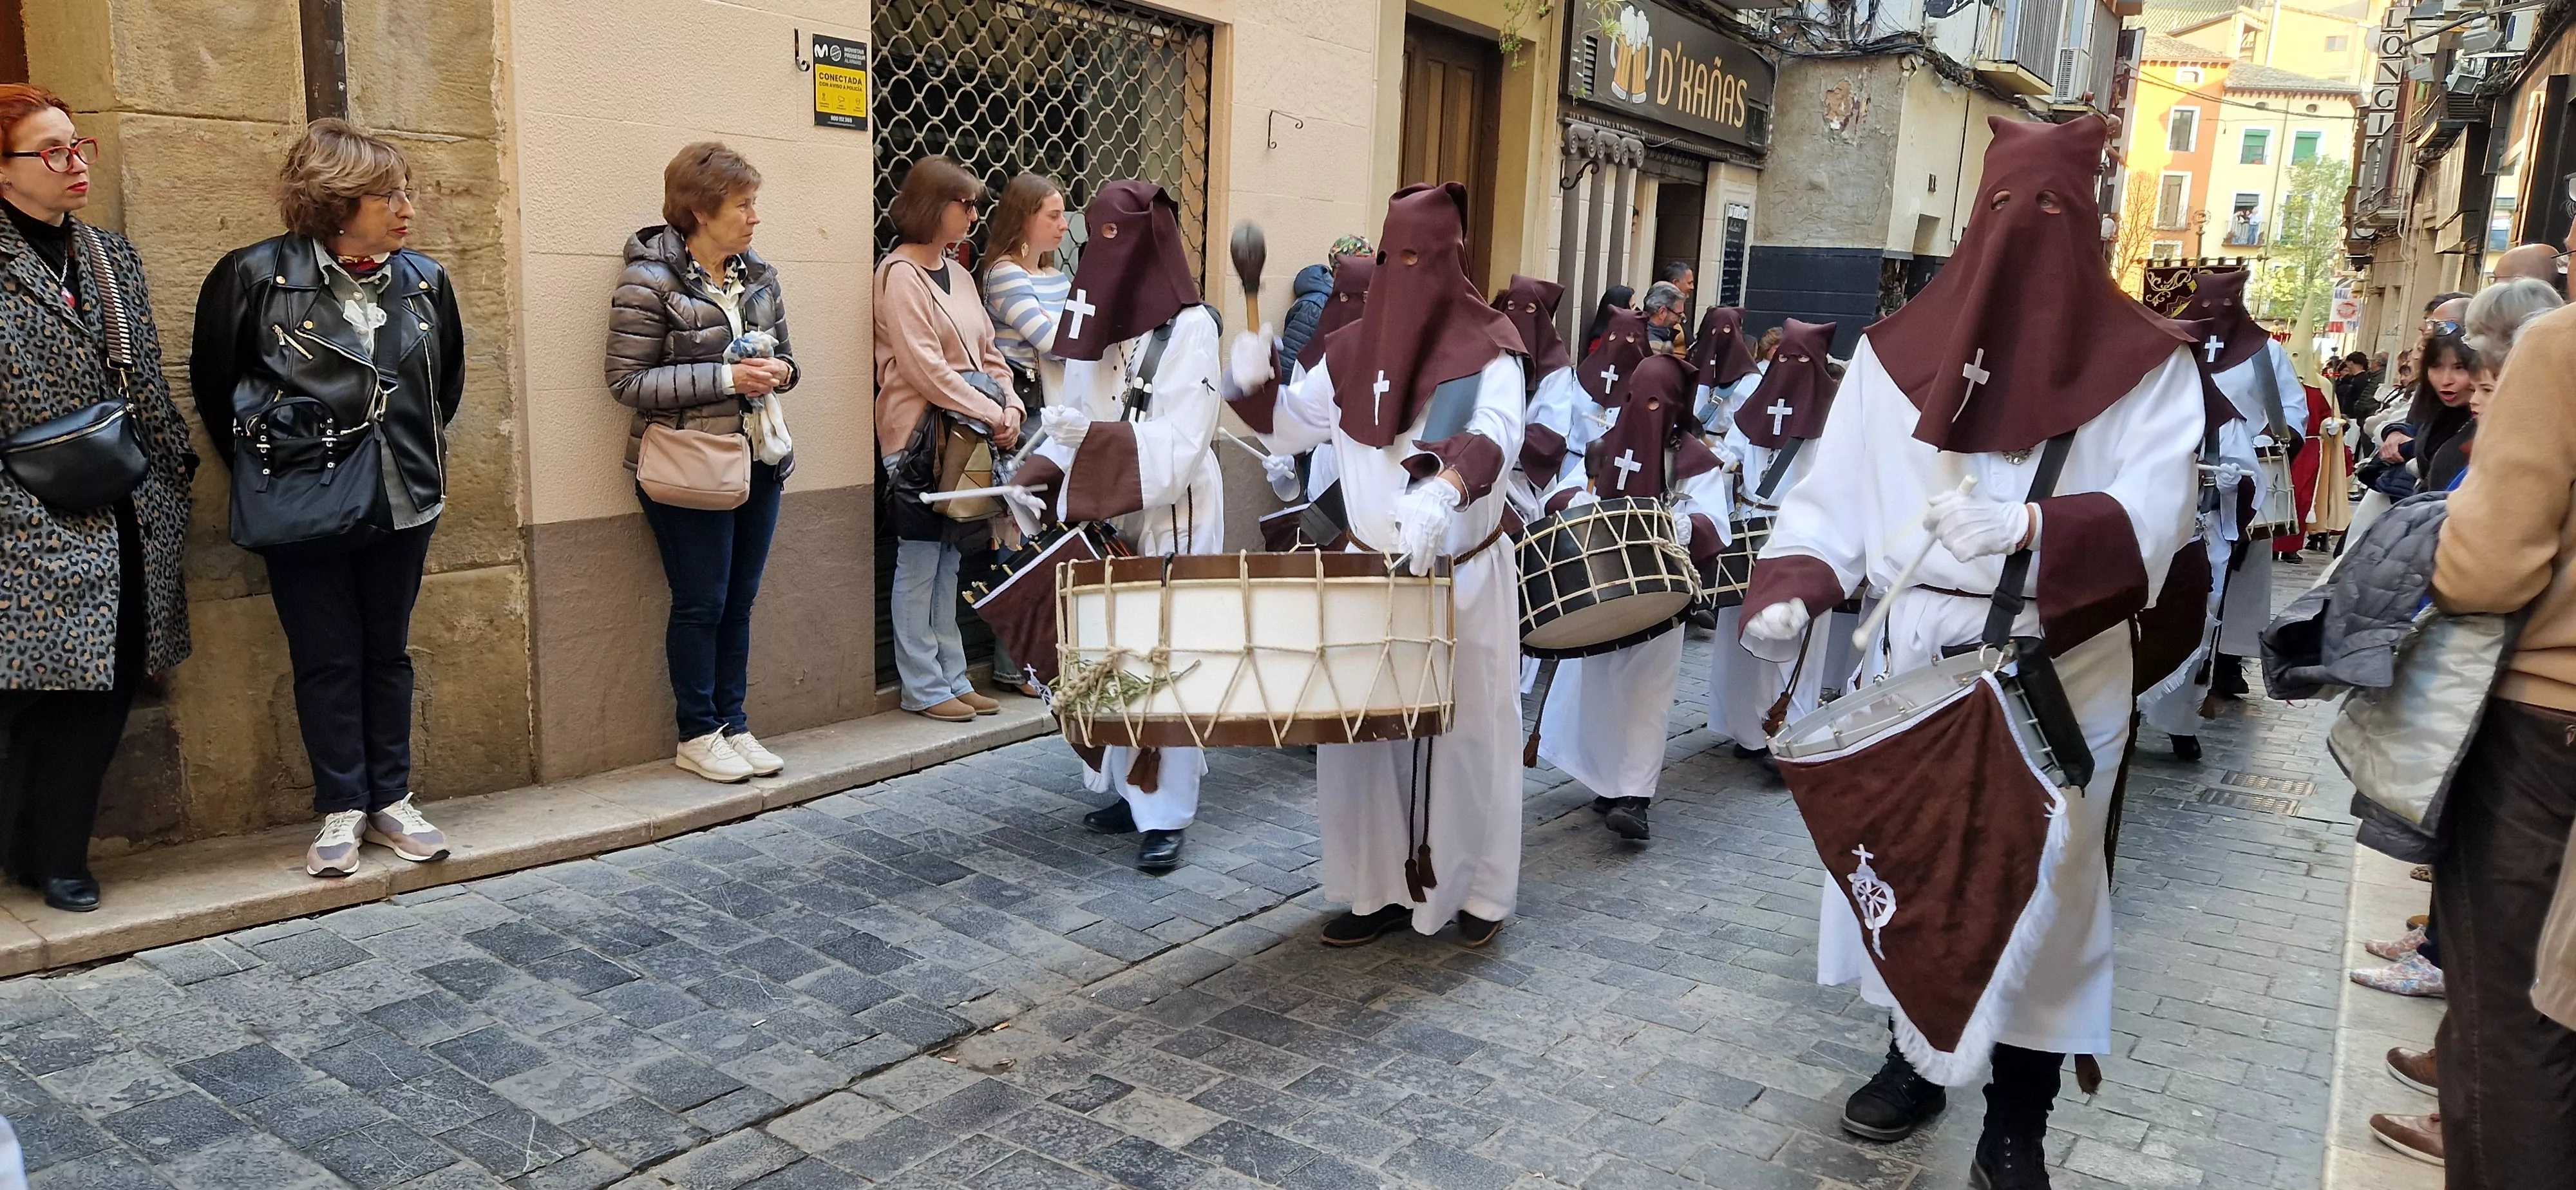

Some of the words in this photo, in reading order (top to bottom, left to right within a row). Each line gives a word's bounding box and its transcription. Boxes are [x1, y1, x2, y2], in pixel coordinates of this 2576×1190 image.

[844, 46, 864, 55] MOVISTAR
[844, 52, 866, 61] PROSEGUR
[819, 72, 862, 86] CONECTADA
[1656, 41, 1747, 128] D'KAÑAS
